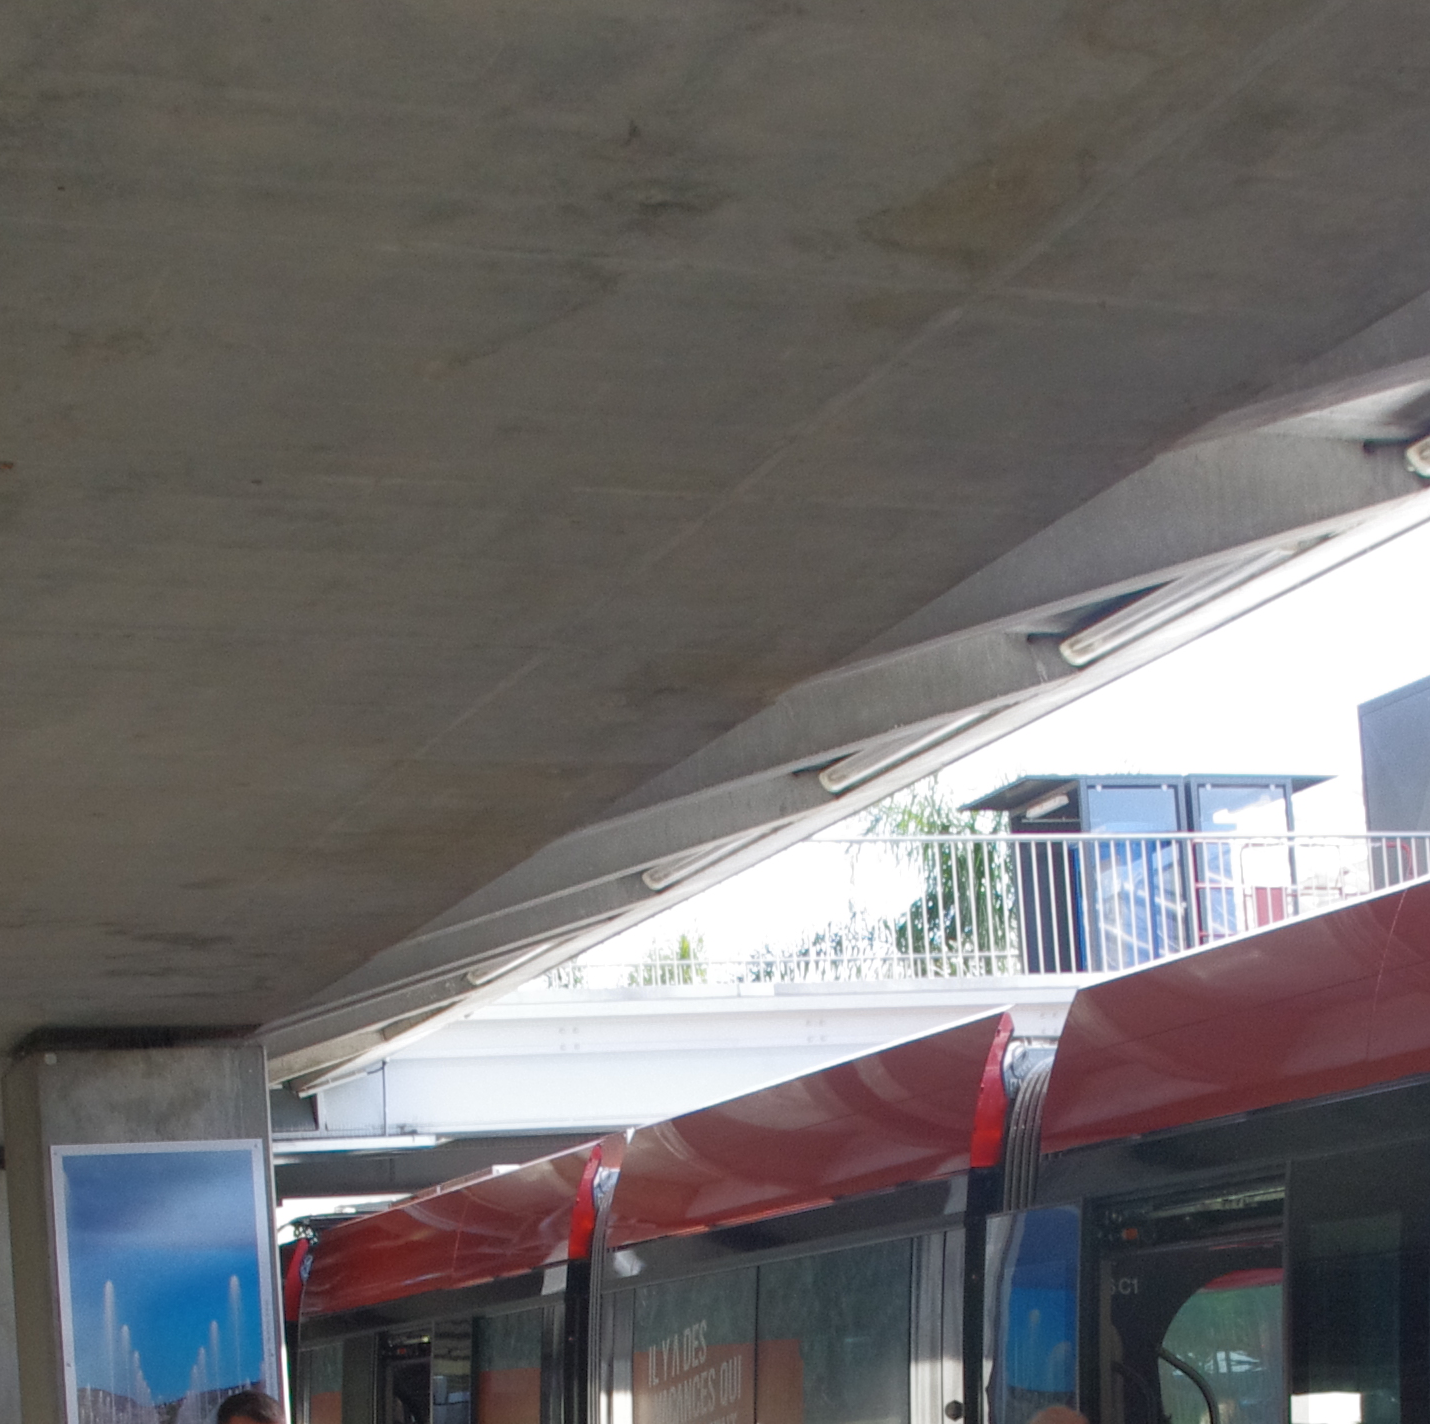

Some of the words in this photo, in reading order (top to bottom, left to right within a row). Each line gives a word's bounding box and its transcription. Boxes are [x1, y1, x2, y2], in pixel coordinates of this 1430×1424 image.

[649, 1345, 659, 1388] IL
[662, 1338, 670, 1381] Y
[683, 1319, 707, 1372] DES
[721, 1355, 741, 1406] QUI
